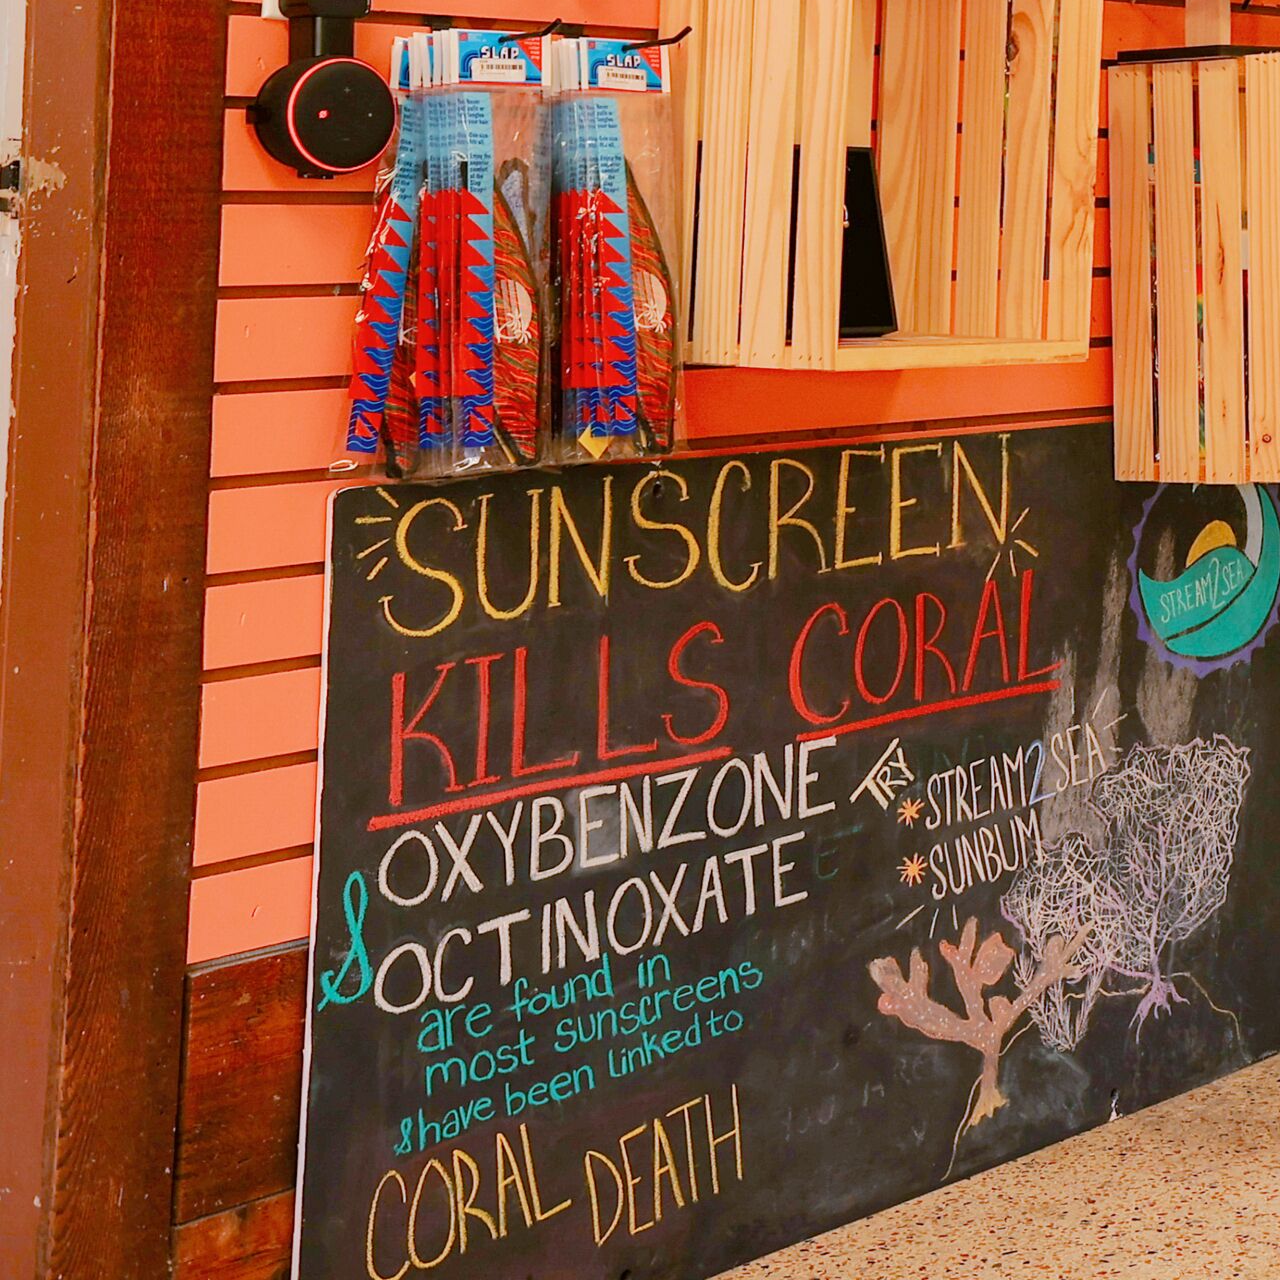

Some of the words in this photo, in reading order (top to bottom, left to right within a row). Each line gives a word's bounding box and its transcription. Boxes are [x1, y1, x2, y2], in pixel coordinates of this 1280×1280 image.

[480, 45, 519, 60] SLAP
[606, 54, 641, 68] SLAP
[380, 434, 1010, 638] SUNSCREEN
[389, 621, 731, 806] KILLS
[788, 569, 1064, 725] CORAL
[378, 737, 837, 906] OXYBENZONE
[850, 737, 916, 811] TRY
[374, 831, 809, 1014] OCTINOXATE
[929, 807, 1043, 901] SUNBUM
[417, 1002, 493, 1052] are
[511, 952, 615, 1022] found
[638, 953, 671, 988] in
[425, 1029, 535, 1097] most
[554, 960, 764, 1054] sunscreens
[417, 1096, 497, 1151] have
[505, 1063, 595, 1117] been
[608, 1024, 701, 1078] linked
[706, 1008, 744, 1040] to
[366, 1123, 572, 1280] CORAL
[583, 1083, 744, 1247] DEATH
